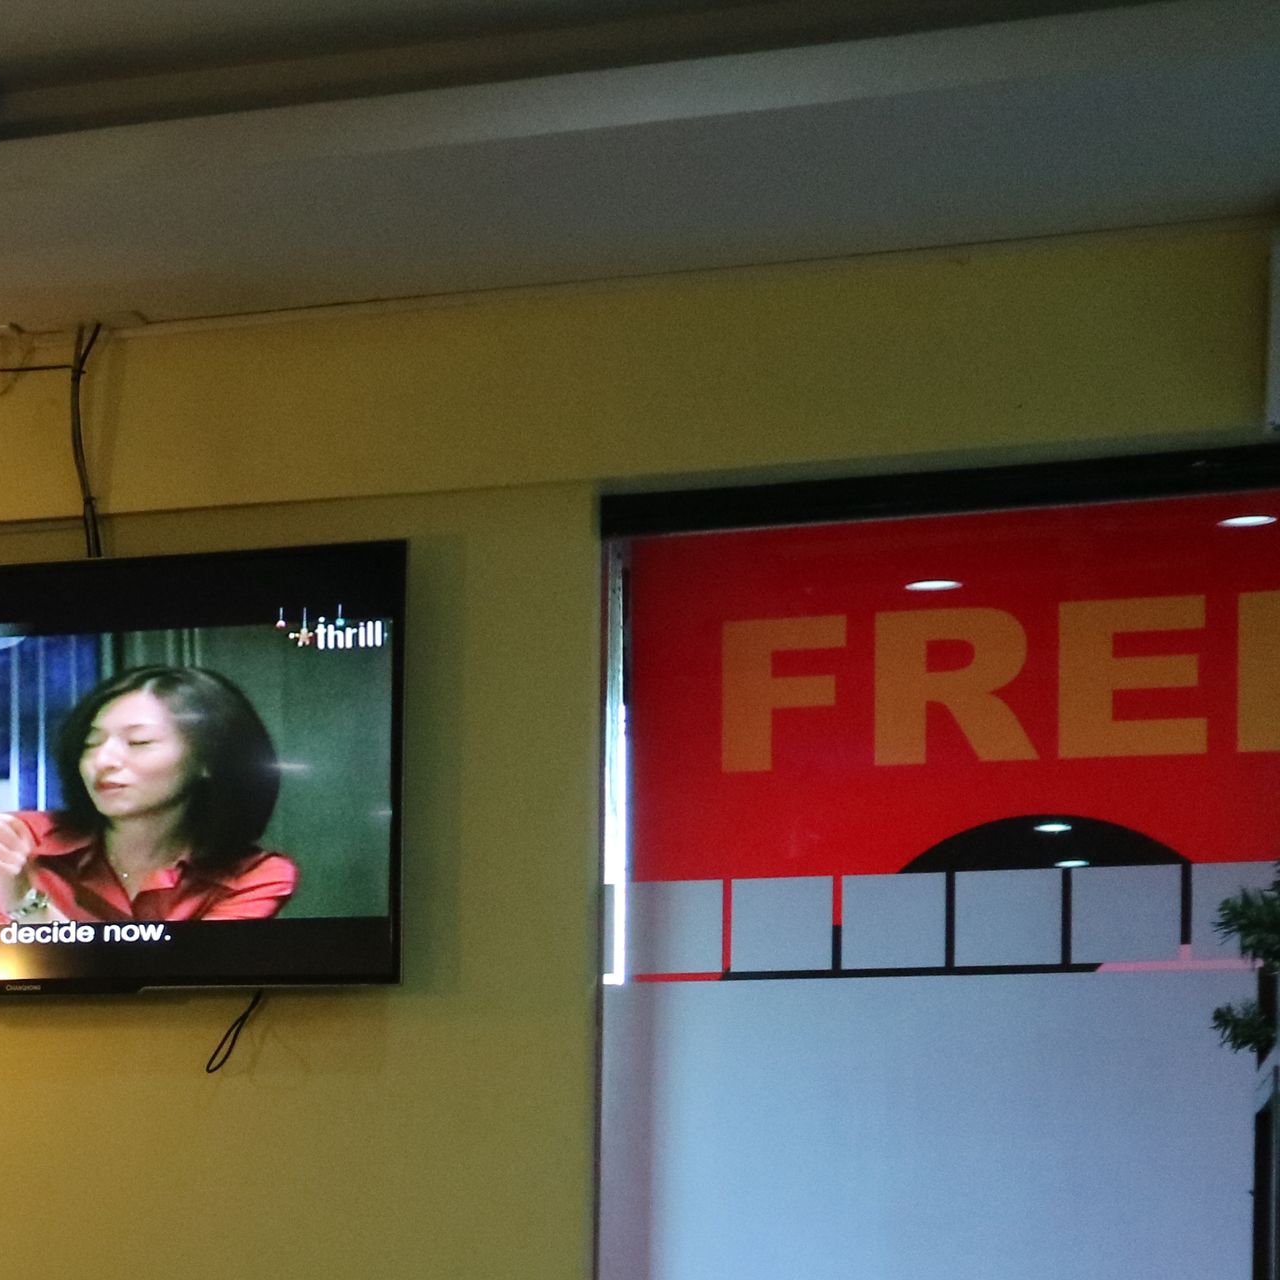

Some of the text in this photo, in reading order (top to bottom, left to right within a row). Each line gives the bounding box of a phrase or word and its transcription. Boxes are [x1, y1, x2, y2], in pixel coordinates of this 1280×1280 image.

[315, 620, 382, 650] thrill
[0, 920, 95, 944] decide
[103, 921, 172, 943] now.
